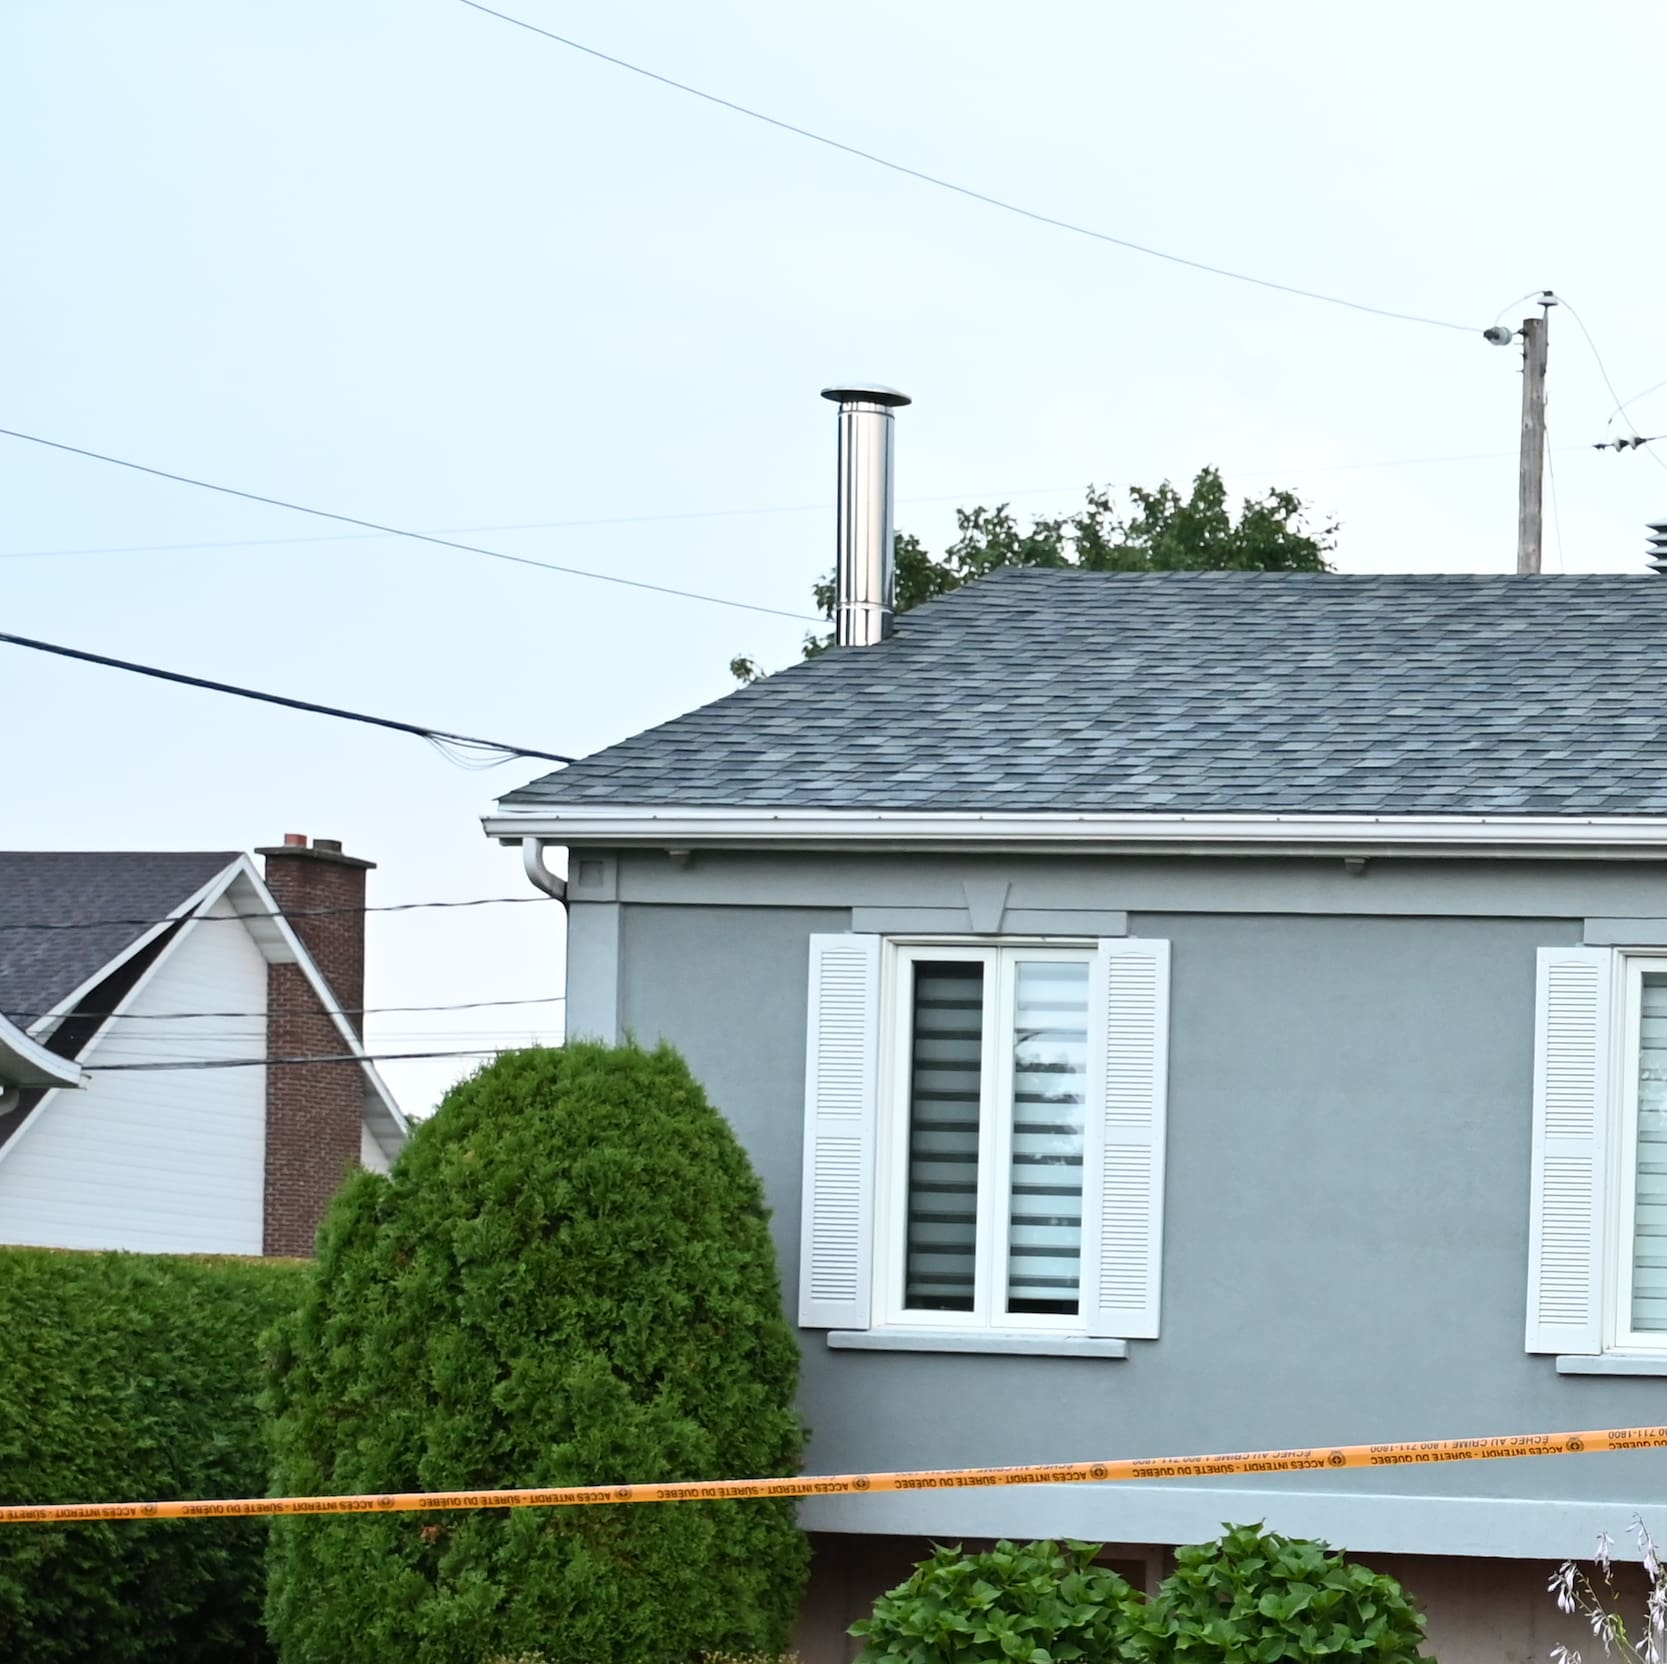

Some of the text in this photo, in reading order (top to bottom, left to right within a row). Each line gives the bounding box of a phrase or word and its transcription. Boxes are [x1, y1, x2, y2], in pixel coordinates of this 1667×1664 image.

[1609, 1429, 1655, 1439] 711-1800
[1416, 1454, 1430, 1462] DU
[1482, 1449, 1527, 1459] INTERDIT
[1371, 1455, 1413, 1465] QUÉBEC
[1177, 1467, 1192, 1475] DU
[1243, 1461, 1288, 1472] INTERDIT
[1132, 1467, 1174, 1478] QUÉBEC
[940, 1478, 953, 1487] DU
[1005, 1473, 1050, 1483] INTERDIT
[768, 1483, 812, 1493] INTERDIT
[895, 1479, 936, 1489] QUÉBEC
[702, 1488, 716, 1497] DU
[464, 1497, 478, 1506] DU
[226, 1504, 241, 1513] DU
